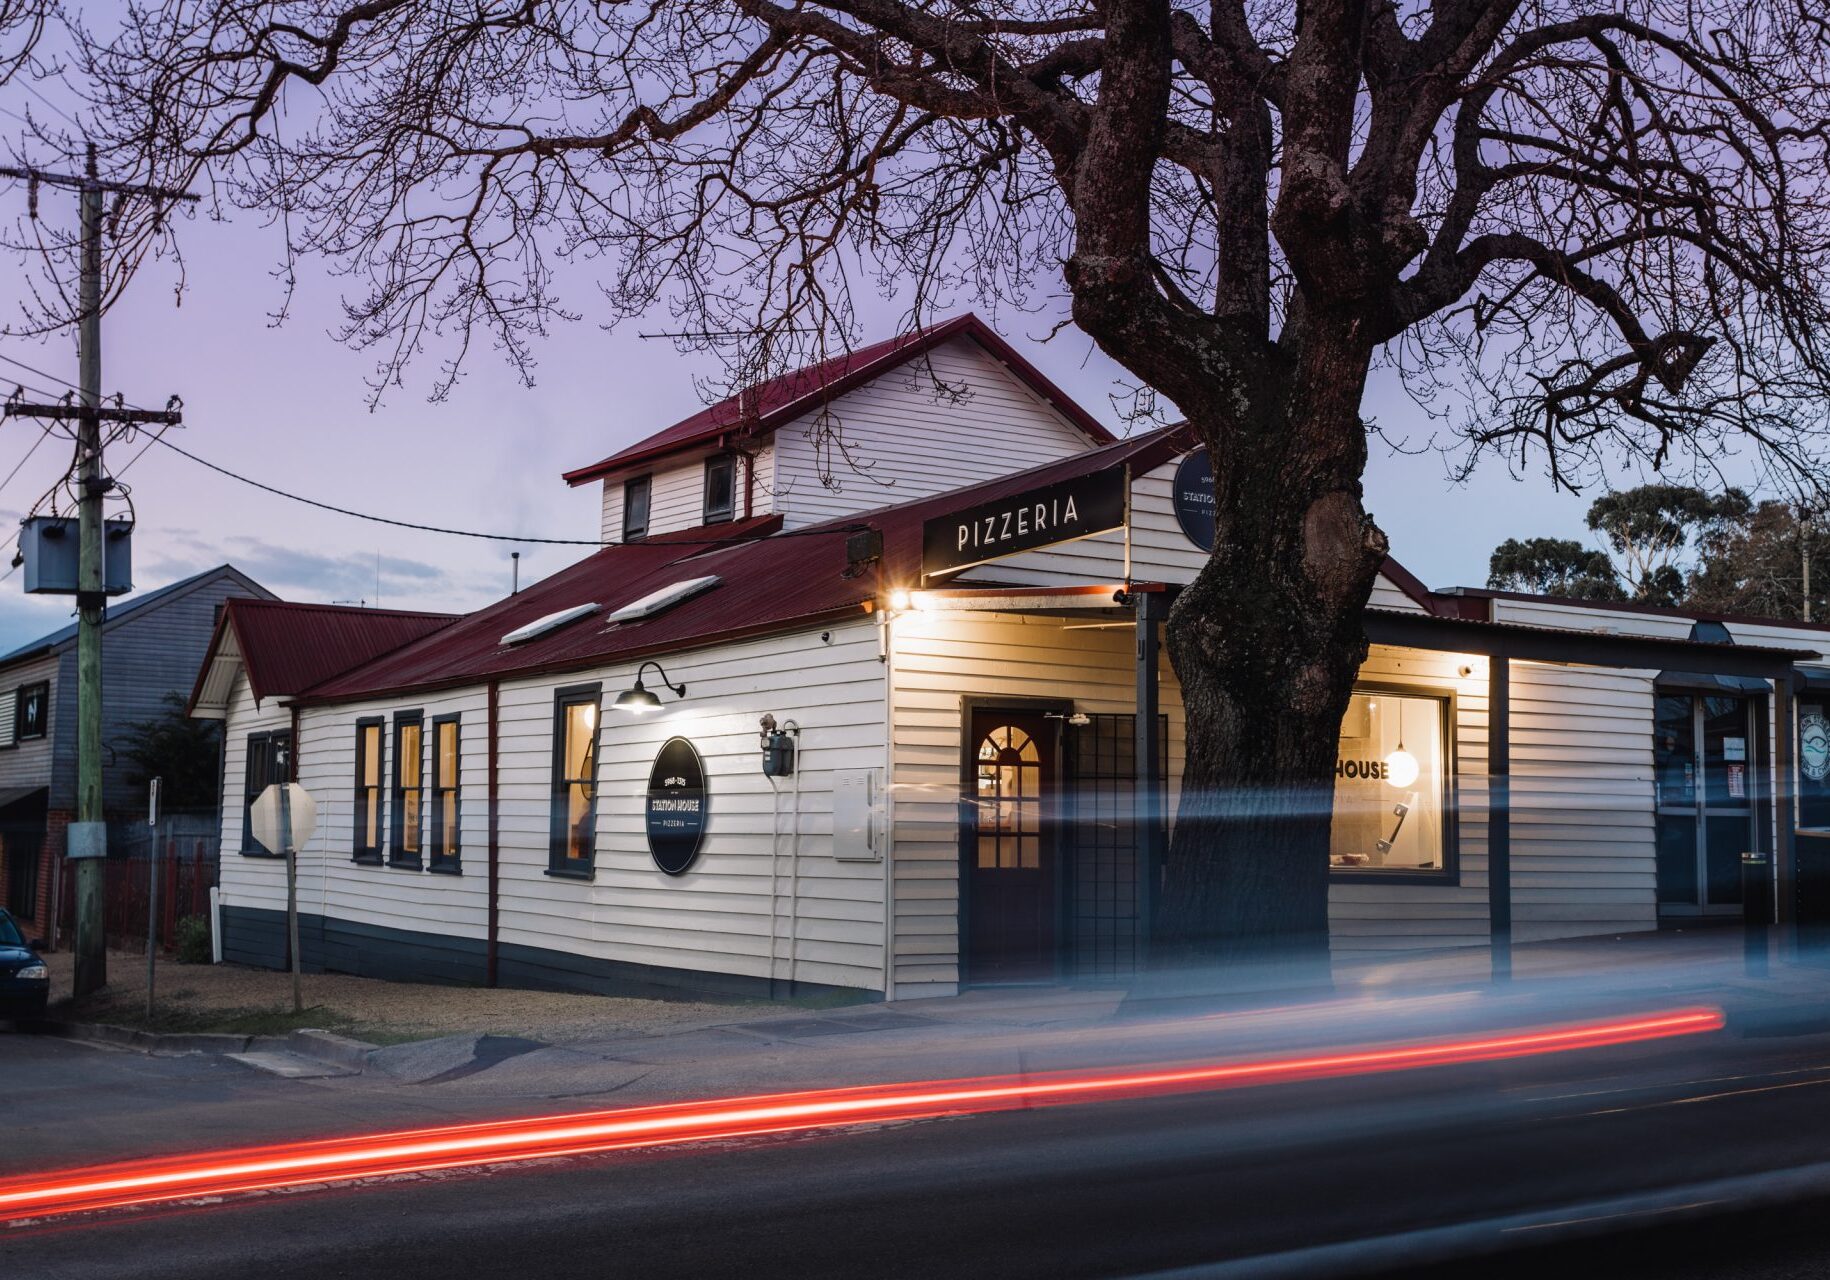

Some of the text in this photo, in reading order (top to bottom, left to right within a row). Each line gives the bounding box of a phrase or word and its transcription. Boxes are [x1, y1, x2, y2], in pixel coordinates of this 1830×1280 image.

[957, 494, 1079, 551] PIZZERIA
[652, 799, 699, 812] STATION HOUSE
[663, 819, 684, 827] PIZZERIA
